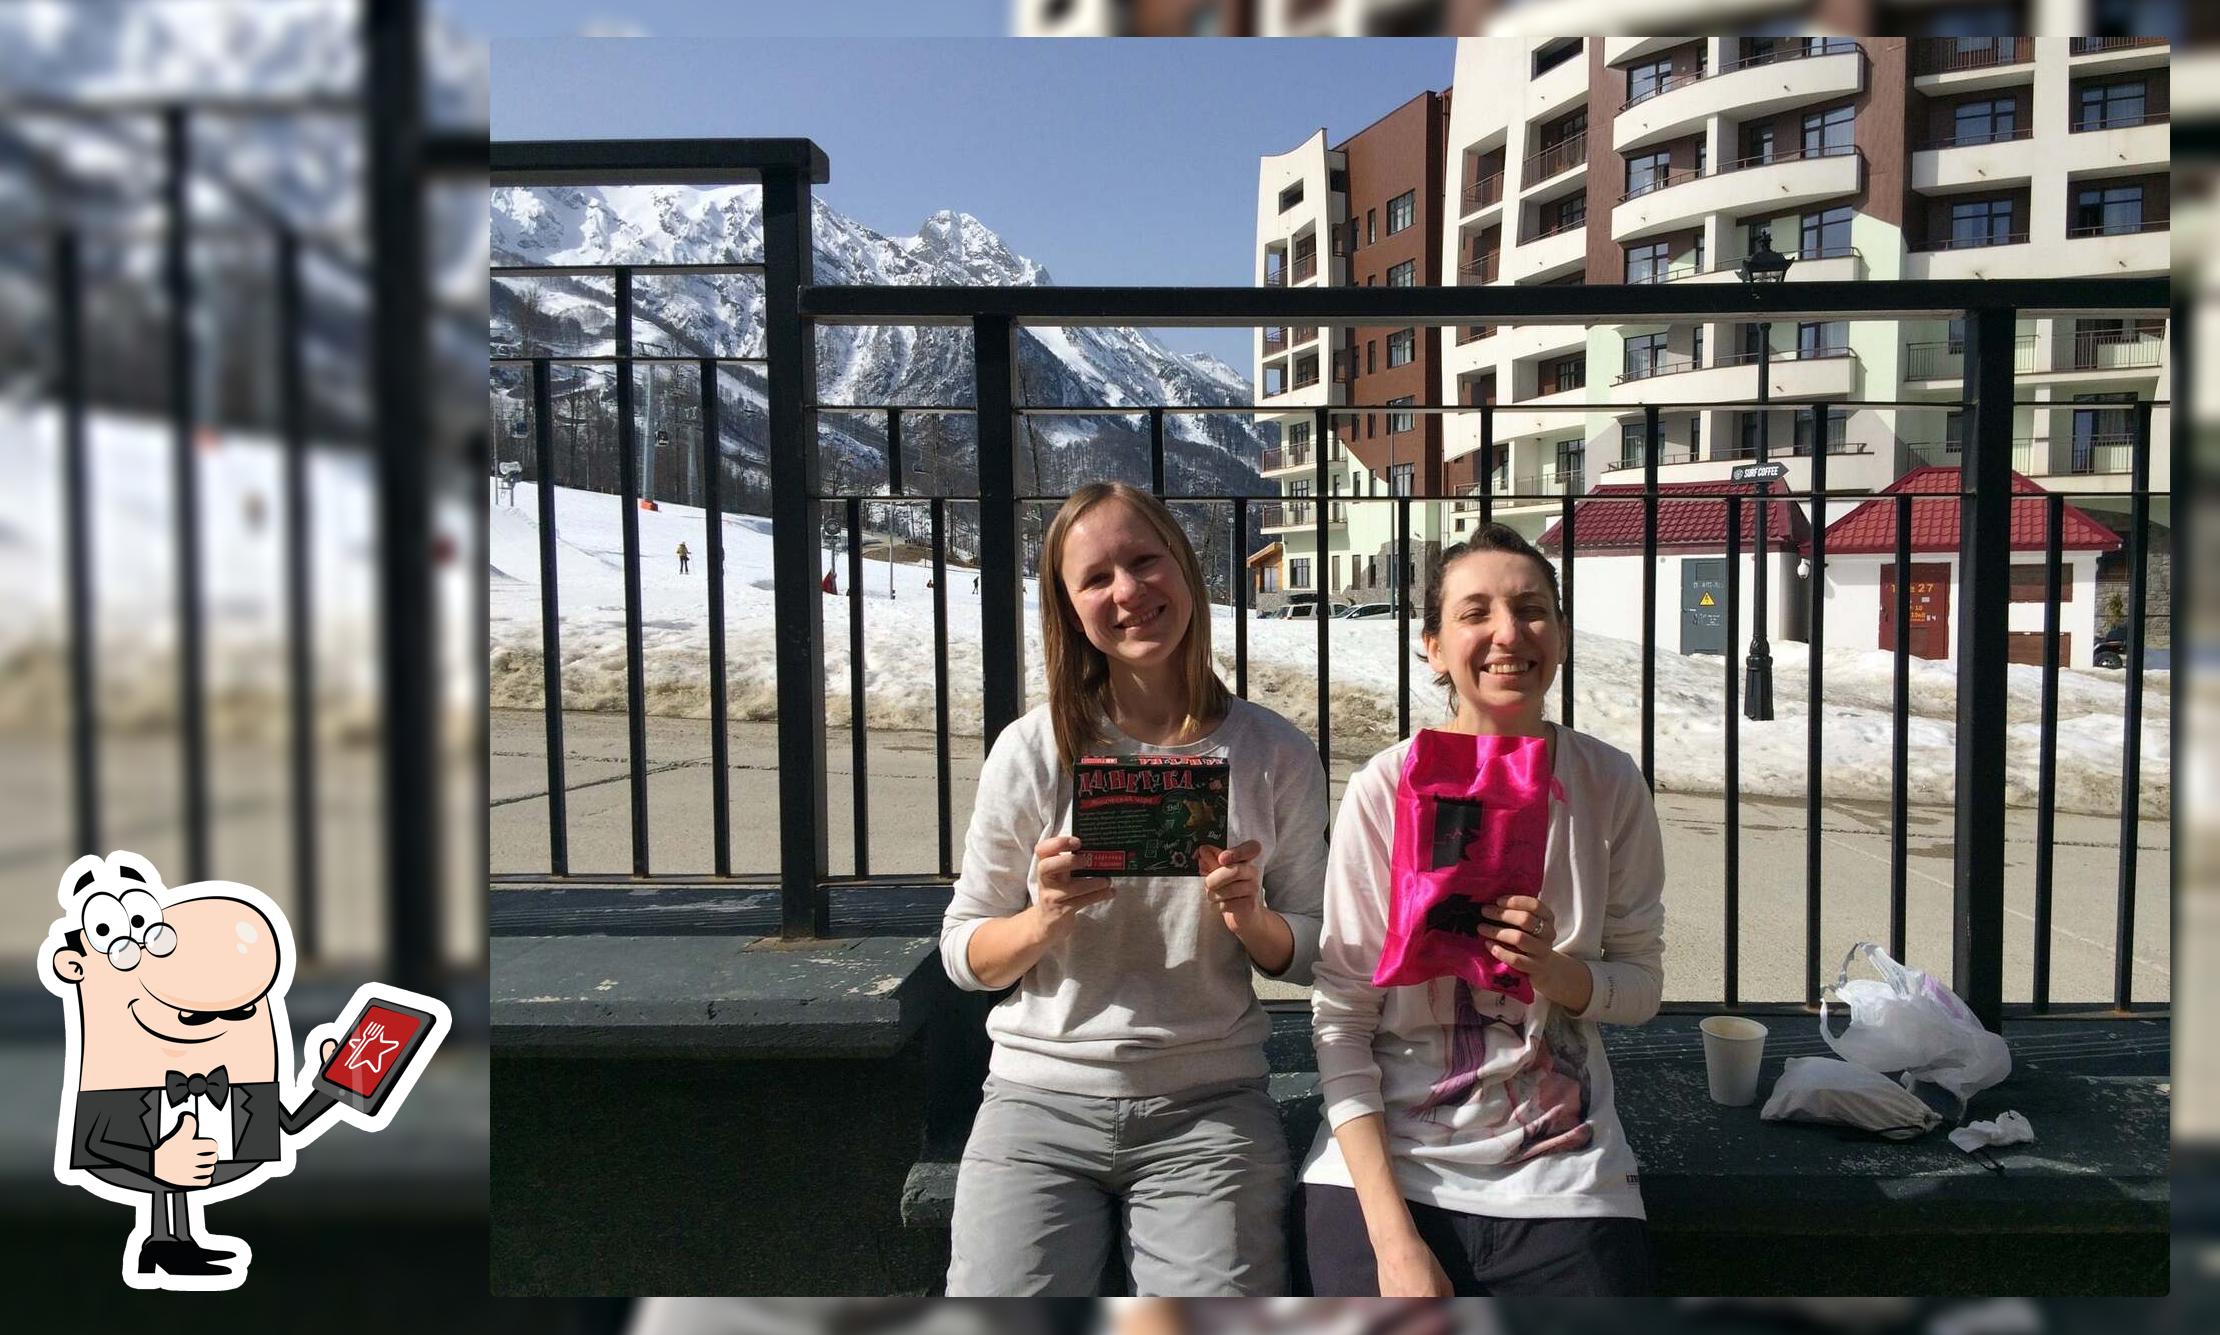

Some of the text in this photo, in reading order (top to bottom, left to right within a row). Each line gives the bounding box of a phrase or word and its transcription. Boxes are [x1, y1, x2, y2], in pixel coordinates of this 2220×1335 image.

[1744, 466, 1779, 478] SURF COFFEE
[1918, 583, 1934, 593] 27
